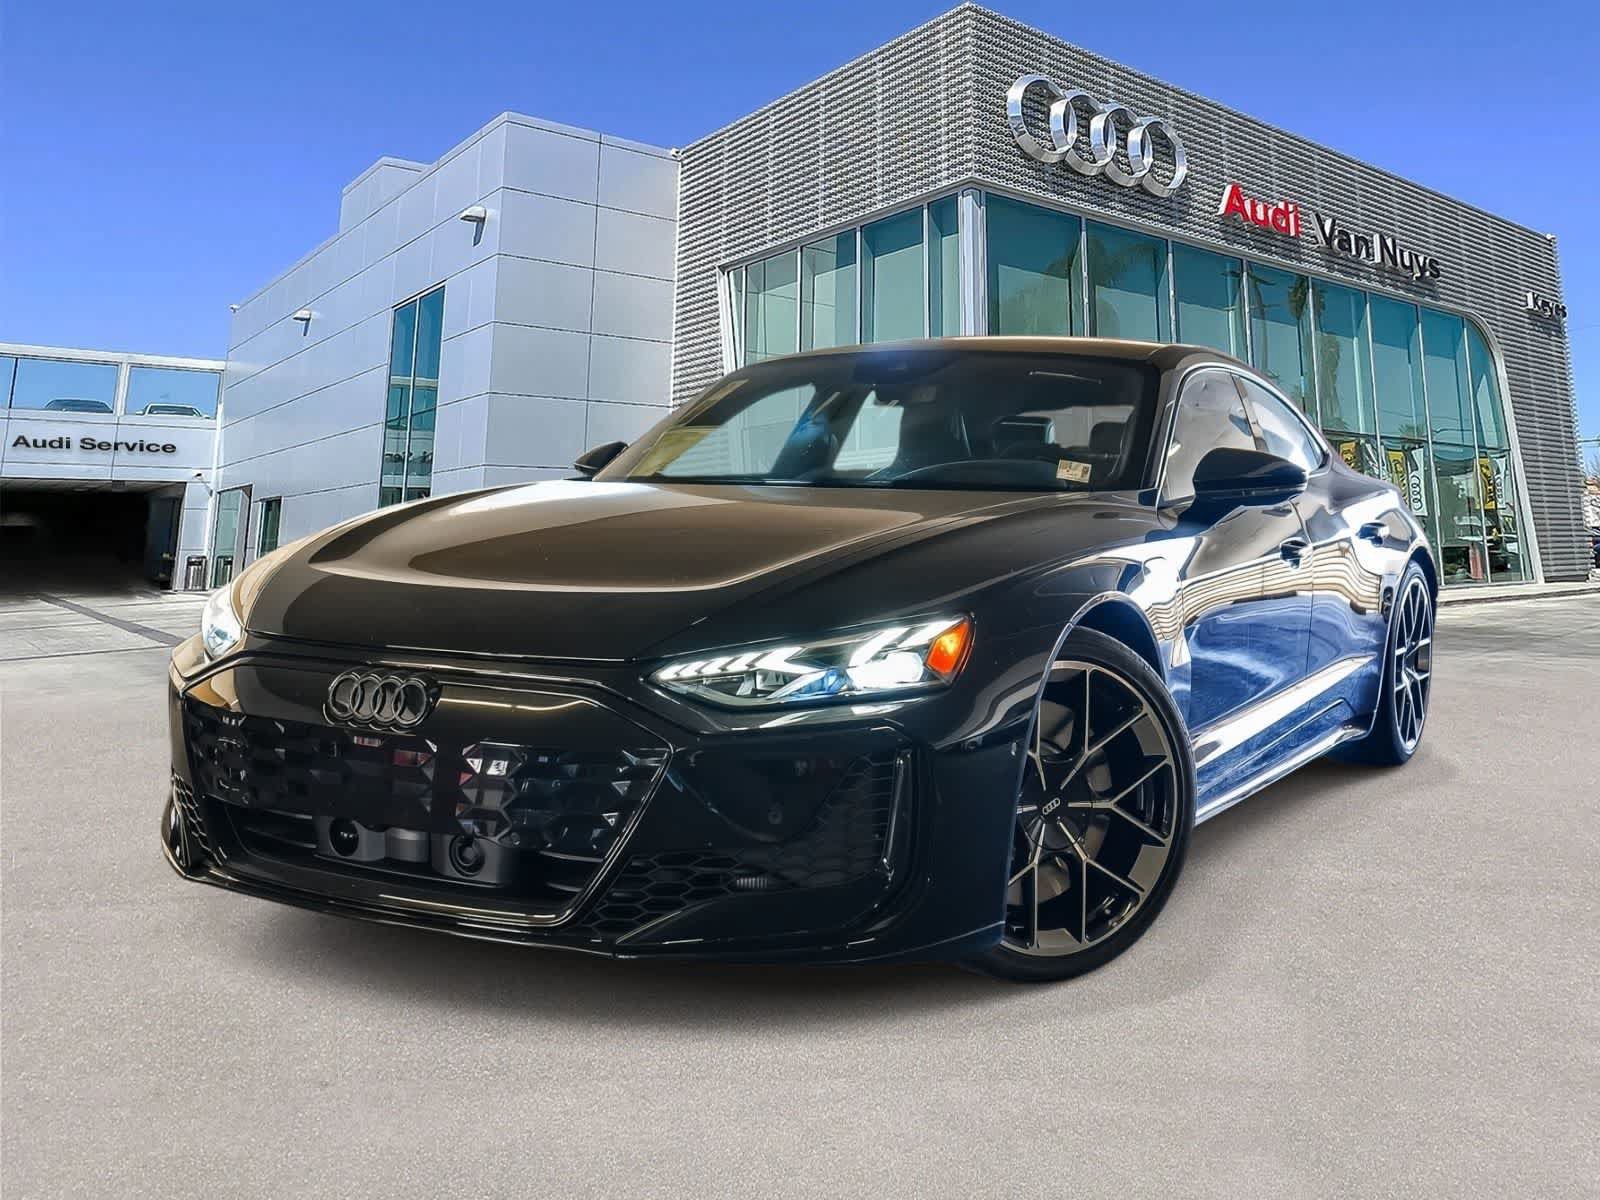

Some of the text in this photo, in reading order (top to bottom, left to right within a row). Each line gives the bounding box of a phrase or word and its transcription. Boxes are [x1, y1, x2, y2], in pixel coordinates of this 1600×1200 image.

[1217, 183, 1441, 281] Audi Van Nuys
[12, 435, 177, 454] Audi Service
